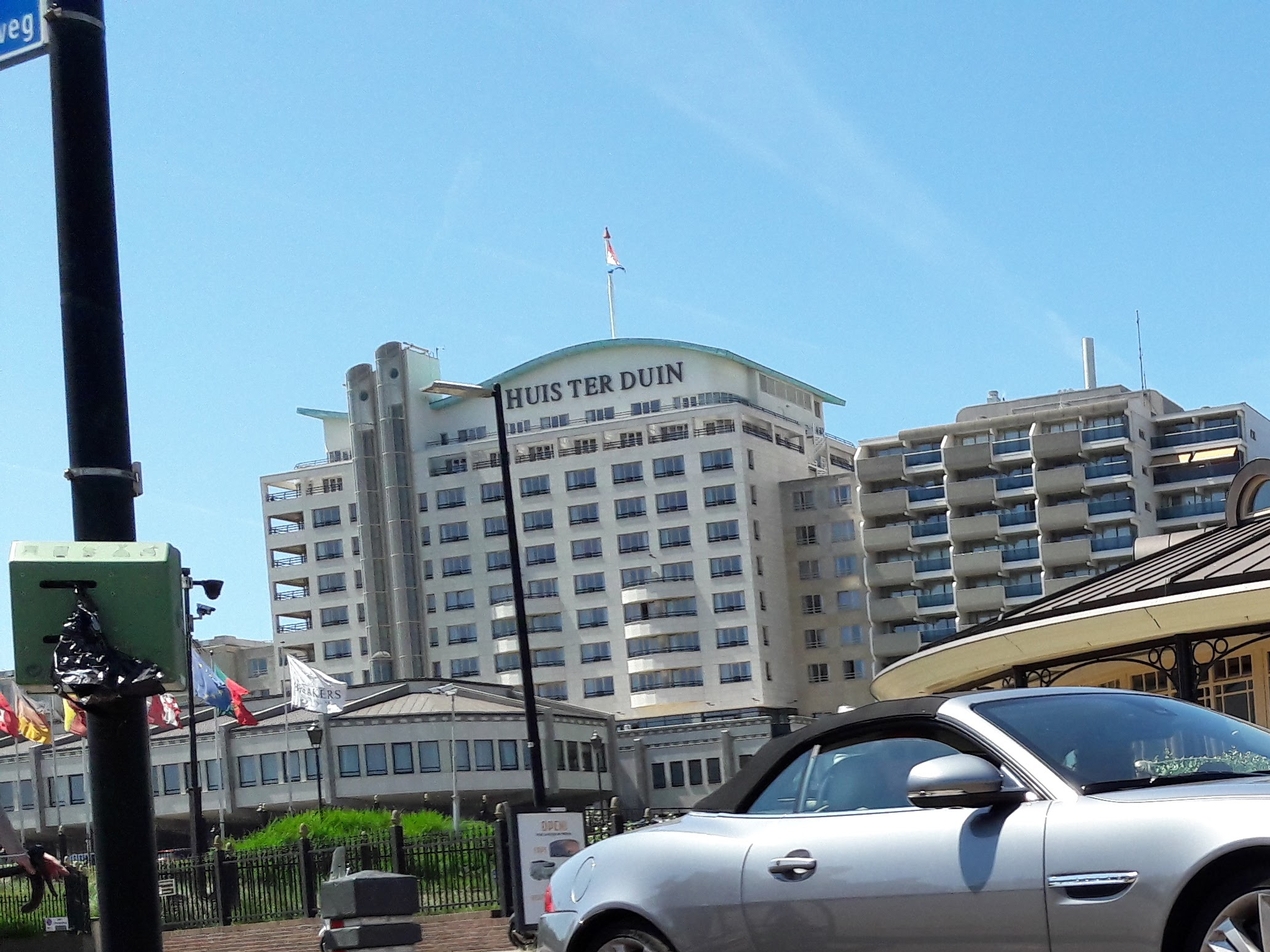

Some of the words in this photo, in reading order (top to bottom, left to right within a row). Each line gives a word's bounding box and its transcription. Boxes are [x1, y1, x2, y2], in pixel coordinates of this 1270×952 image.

[505, 382, 562, 409] HUIS
[567, 374, 614, 398] TER
[619, 361, 684, 390] DUIN
